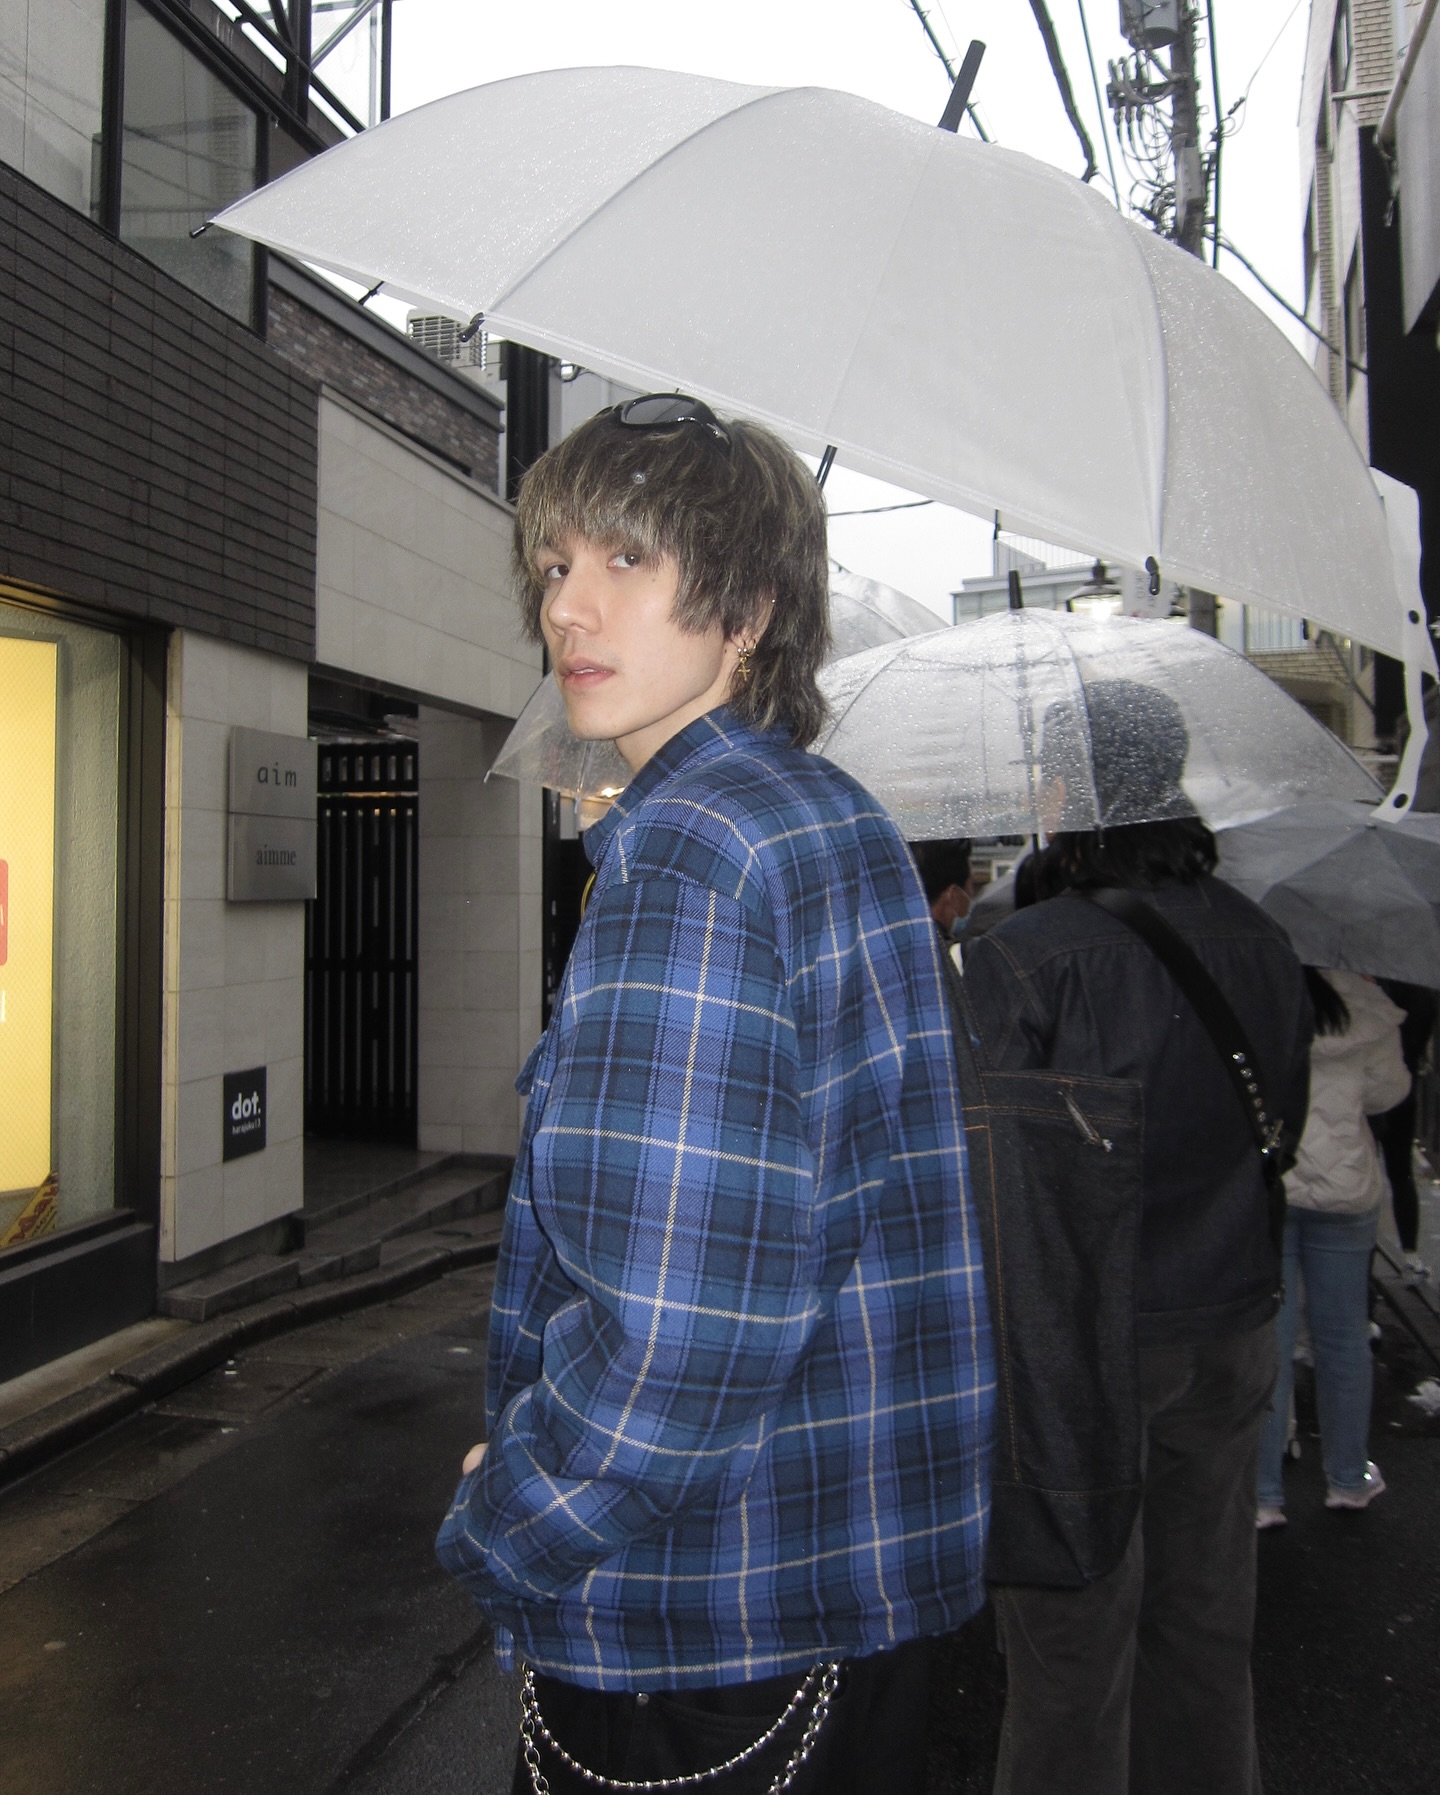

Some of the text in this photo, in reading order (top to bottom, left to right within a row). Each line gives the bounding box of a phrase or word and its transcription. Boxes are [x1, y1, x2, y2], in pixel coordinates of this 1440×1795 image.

[257, 761, 297, 787] aim
[256, 844, 297, 866] aimme
[232, 1090, 261, 1120] dot.
